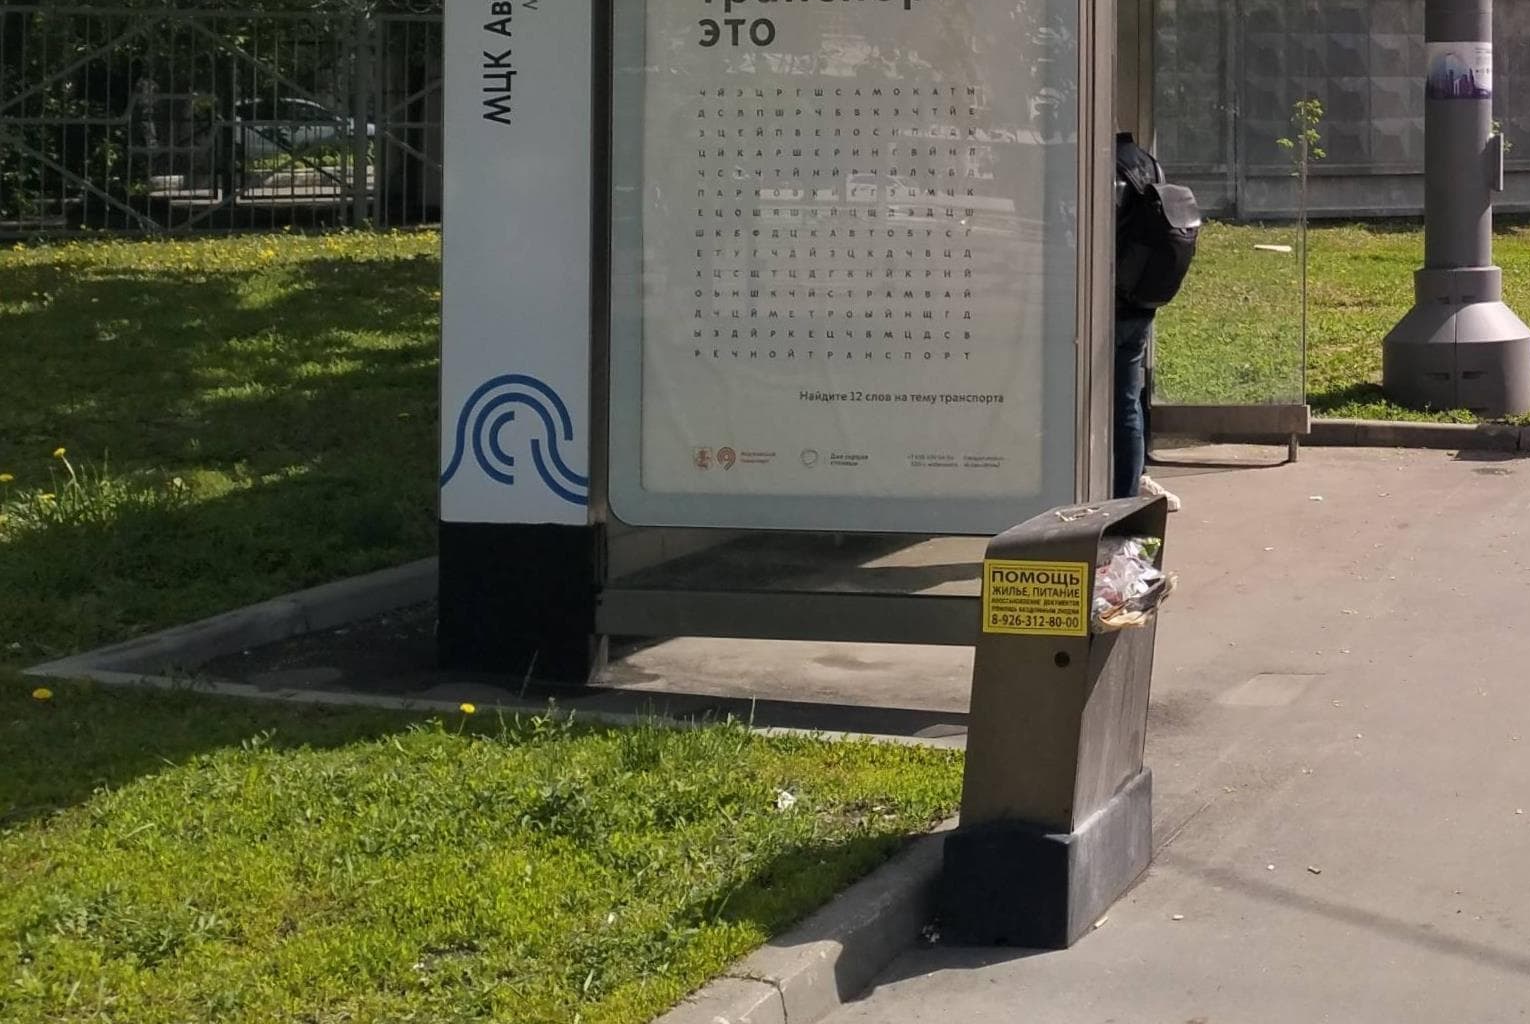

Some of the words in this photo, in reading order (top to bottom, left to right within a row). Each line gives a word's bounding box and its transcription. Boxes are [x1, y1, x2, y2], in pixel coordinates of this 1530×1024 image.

[698, 18, 776, 48] это
[483, 49, 518, 125] МЦК
[799, 390, 848, 402] Найдите
[850, 392, 862, 402] 12
[865, 392, 892, 403] слов
[894, 393, 908, 403] на
[910, 393, 937, 406] тему
[939, 392, 1005, 406] транспорта
[992, 570, 1080, 588] ПОМОЩЬ
[1033, 587, 1080, 598] ПИТАНИЕ
[991, 614, 1079, 628] 8-926-312-80-00
